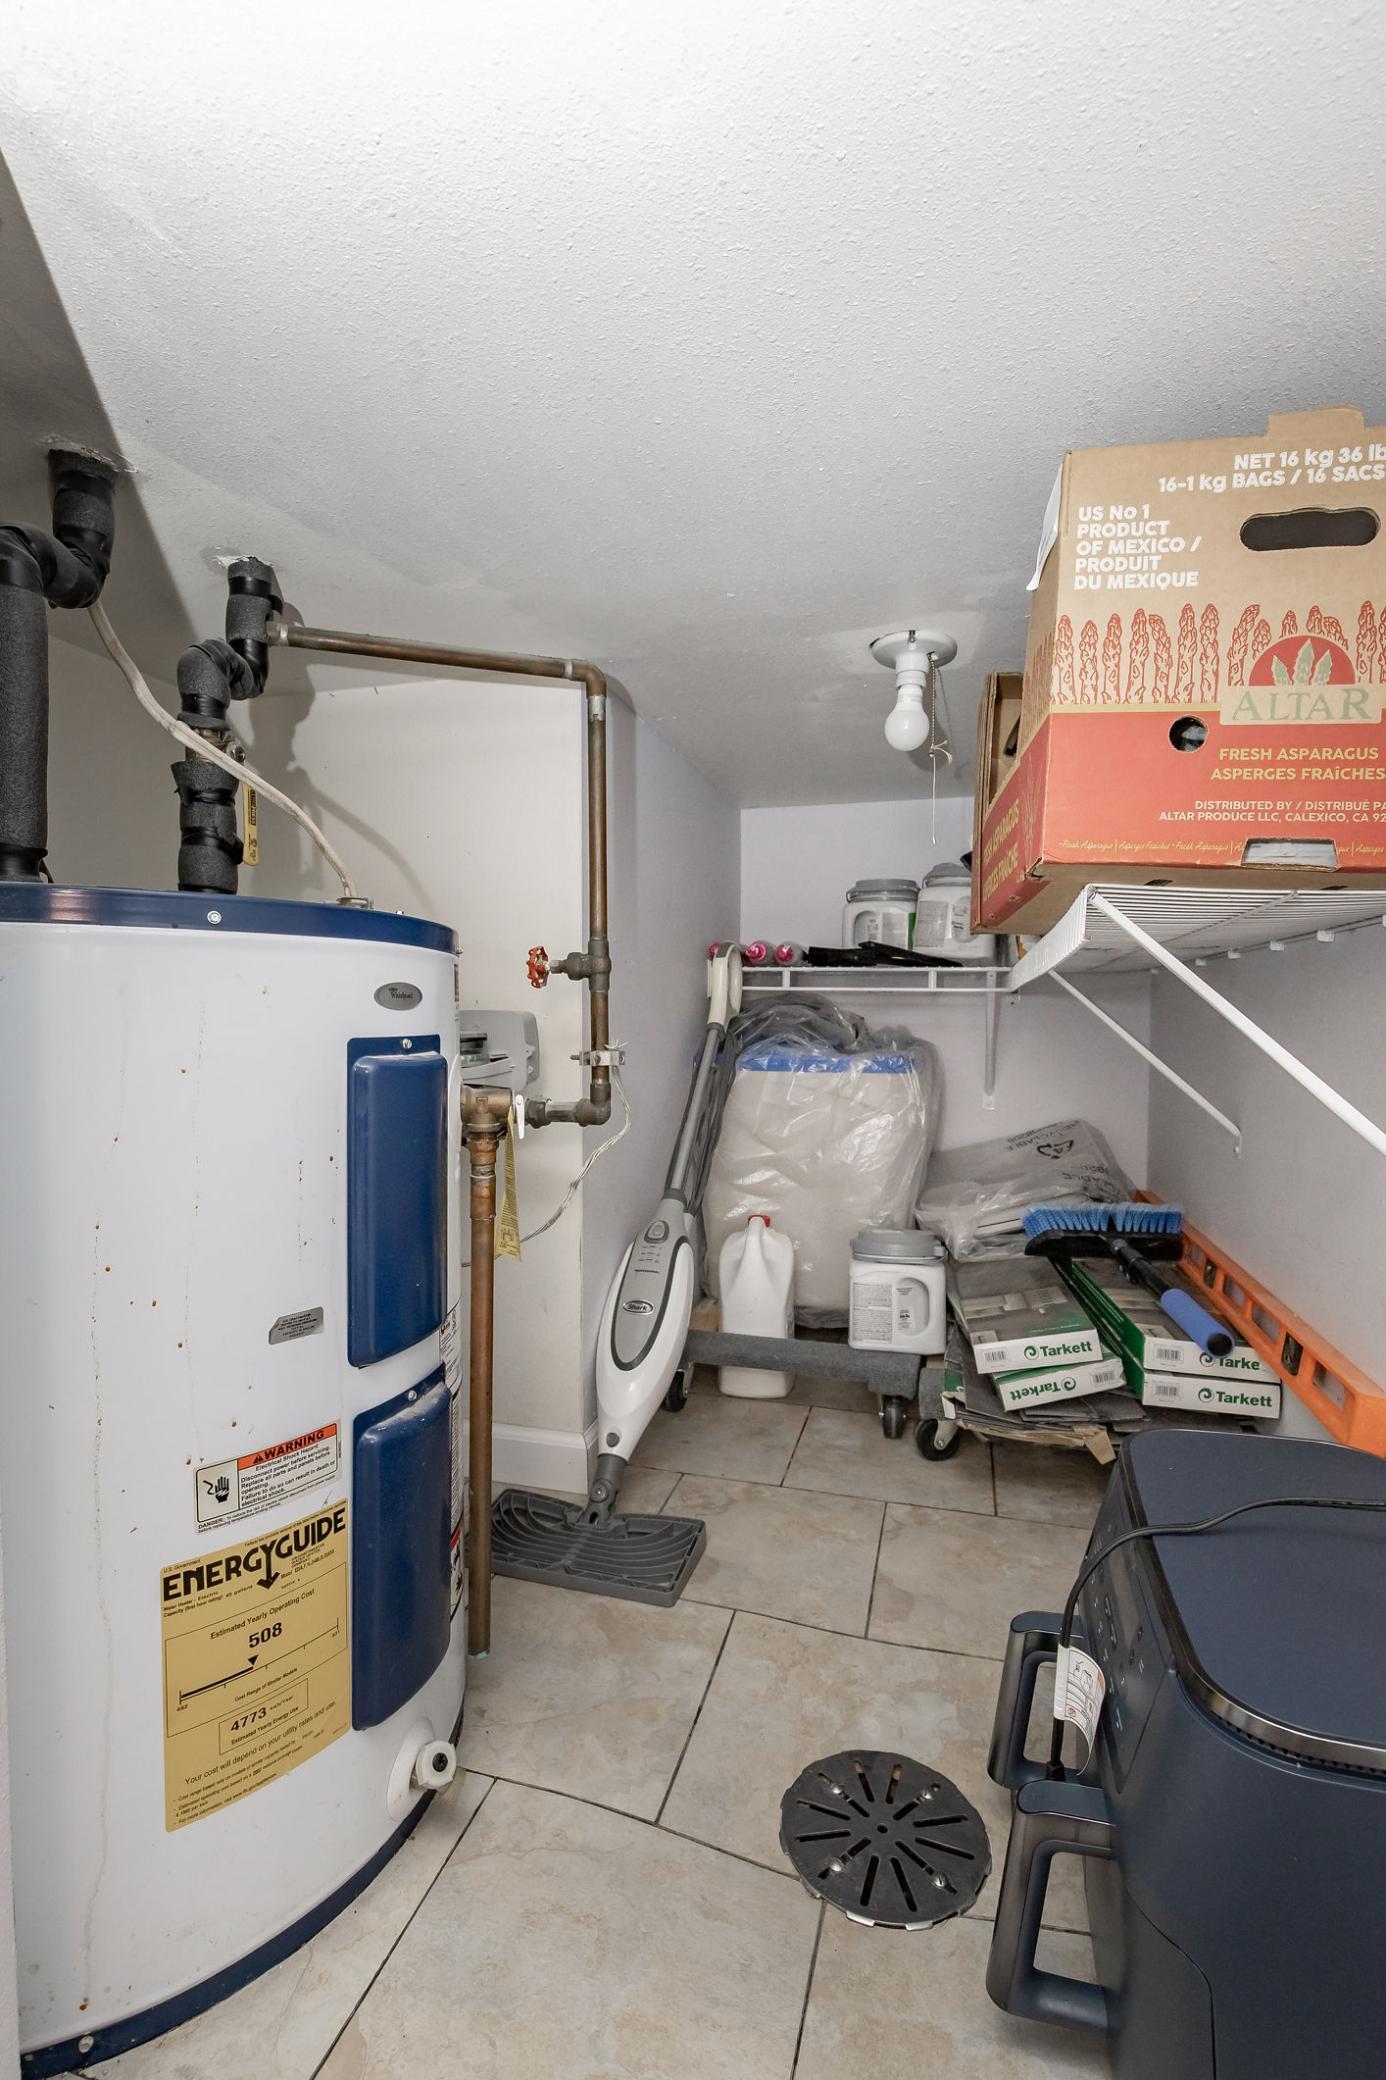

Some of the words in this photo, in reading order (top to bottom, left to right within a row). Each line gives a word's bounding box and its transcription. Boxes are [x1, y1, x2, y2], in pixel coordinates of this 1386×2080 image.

[1234, 452, 1275, 470] NET
[1280, 450, 1299, 467] 16
[1304, 446, 1333, 468] kg
[1338, 446, 1363, 464] 36
[1159, 475, 1194, 493] 16-1
[1199, 473, 1227, 493] kg
[1232, 470, 1286, 488] BAGS
[1290, 468, 1302, 485] /
[1306, 466, 1326, 484] 16
[1331, 464, 1386, 482] SACS
[1078, 505, 1104, 521] US
[1109, 505, 1137, 520] No
[1142, 503, 1150, 519] 1
[1077, 520, 1170, 538] PRODUCT
[1076, 540, 1104, 555] OF
[1108, 536, 1186, 555] MEXICO
[1190, 535, 1202, 552] /
[1075, 555, 1162, 573] PRODUIT
[1074, 574, 1102, 590] DU
[1107, 571, 1199, 591] MEXIQUE
[1232, 688, 1373, 721] ALTAR
[1219, 748, 1272, 760] FRESH
[1276, 747, 1379, 760] ASPARAGUS
[1210, 768, 1297, 780] ASPERGES
[1301, 765, 1386, 780] FRAÎCHES
[1195, 800, 1273, 810] DISTRIBUTED
[1276, 801, 1292, 811] BY
[1296, 801, 1301, 811] /
[1305, 799, 1370, 811] DISTRIBUÉ
[1373, 801, 1386, 811] PA
[1159, 811, 1194, 821] ALTAR
[1197, 811, 1255, 821] PRODUCE
[1258, 812, 1282, 823] LLC,
[1285, 812, 1349, 824] CALEXICO,
[1352, 812, 1369, 822] CA
[1373, 813, 1386, 822] 92
[628, 1303, 648, 1311] Shark
[1040, 1341, 1093, 1357] Tarkett
[1219, 1357, 1260, 1370] Tarke
[1010, 1381, 1061, 1400] Tarkett
[1216, 1391, 1273, 1407] Tarkett
[263, 1430, 325, 1460] WARNING
[241, 1469, 273, 1483] Disconnect
[241, 1478, 264, 1489] Replace
[273, 1470, 287, 1478] parts
[287, 1465, 297, 1473] and
[241, 1490, 261, 1501] Failure
[284, 1478, 295, 1486] can
[295, 1472, 309, 1480] result
[241, 1494, 268, 1507] electrical
[163, 1507, 346, 1602] ENERGYGUIDE
[210, 1621, 246, 1640] Estimated
[246, 1611, 268, 1625] Yearly
[269, 1596, 300, 1615] Operating
[301, 1588, 315, 1600] Cost
[248, 1622, 283, 1648] 508
[230, 1706, 268, 1732] 4773
[231, 1729, 257, 1745] Estimated
[289, 1706, 299, 1715] Use
[185, 1773, 203, 1785] Your
[203, 1766, 219, 1778] cost
[219, 1759, 232, 1770] will
[232, 1746, 258, 1765] depend
[258, 1743, 267, 1751] on
[268, 1735, 282, 1749] your
[314, 1707, 325, 1718] and
